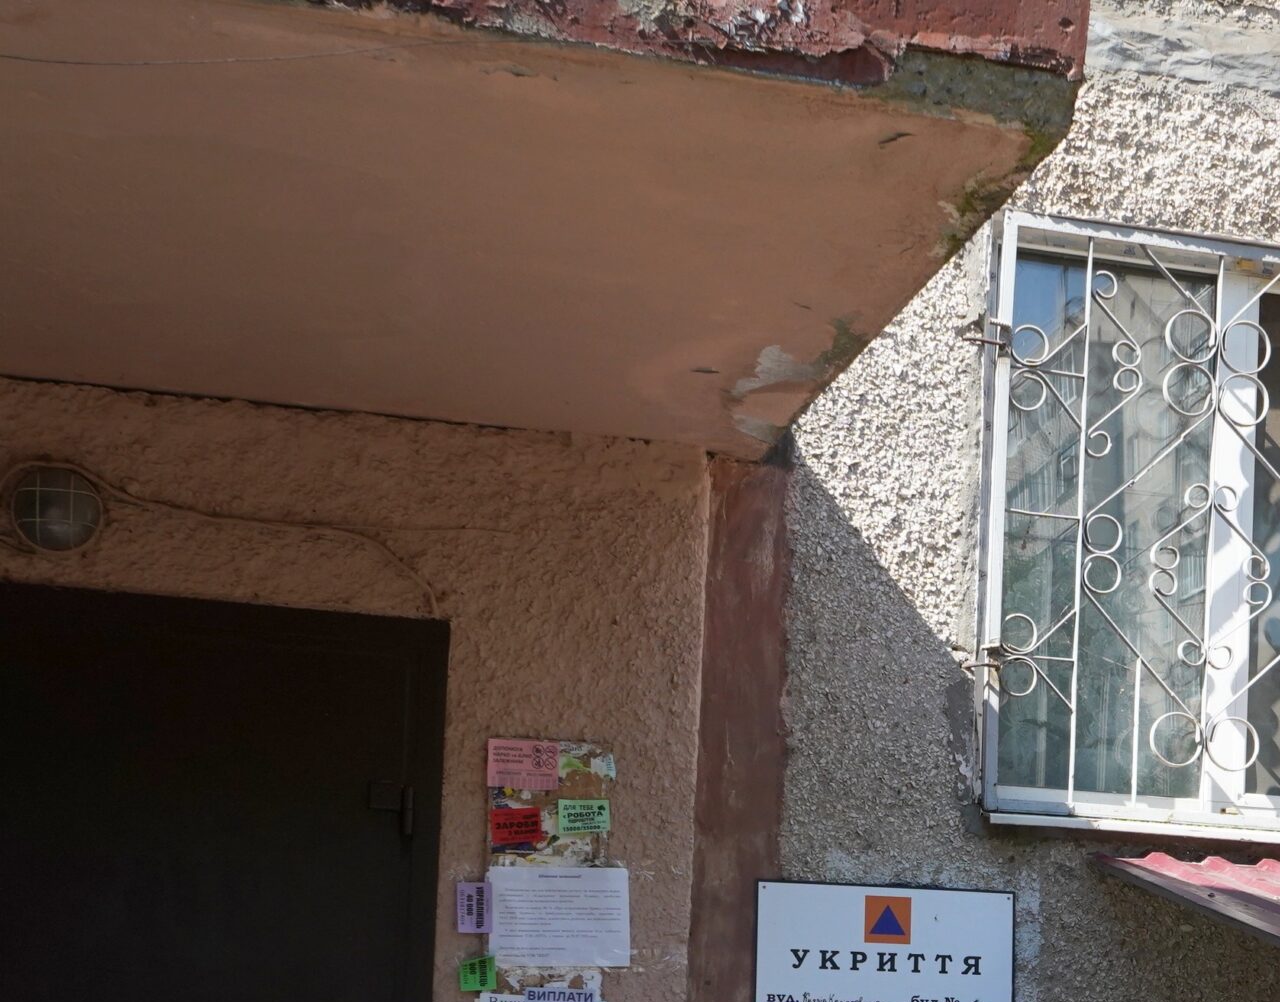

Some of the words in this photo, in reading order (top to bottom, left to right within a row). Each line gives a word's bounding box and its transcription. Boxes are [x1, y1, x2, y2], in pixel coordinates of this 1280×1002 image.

[567, 811, 603, 819] РОБОТА
[475, 886, 484, 929] УПРАВЛІНЕЦЬ
[790, 948, 982, 975] УКРИТТЯ
[527, 990, 593, 1002] ВИПЛАТИ
